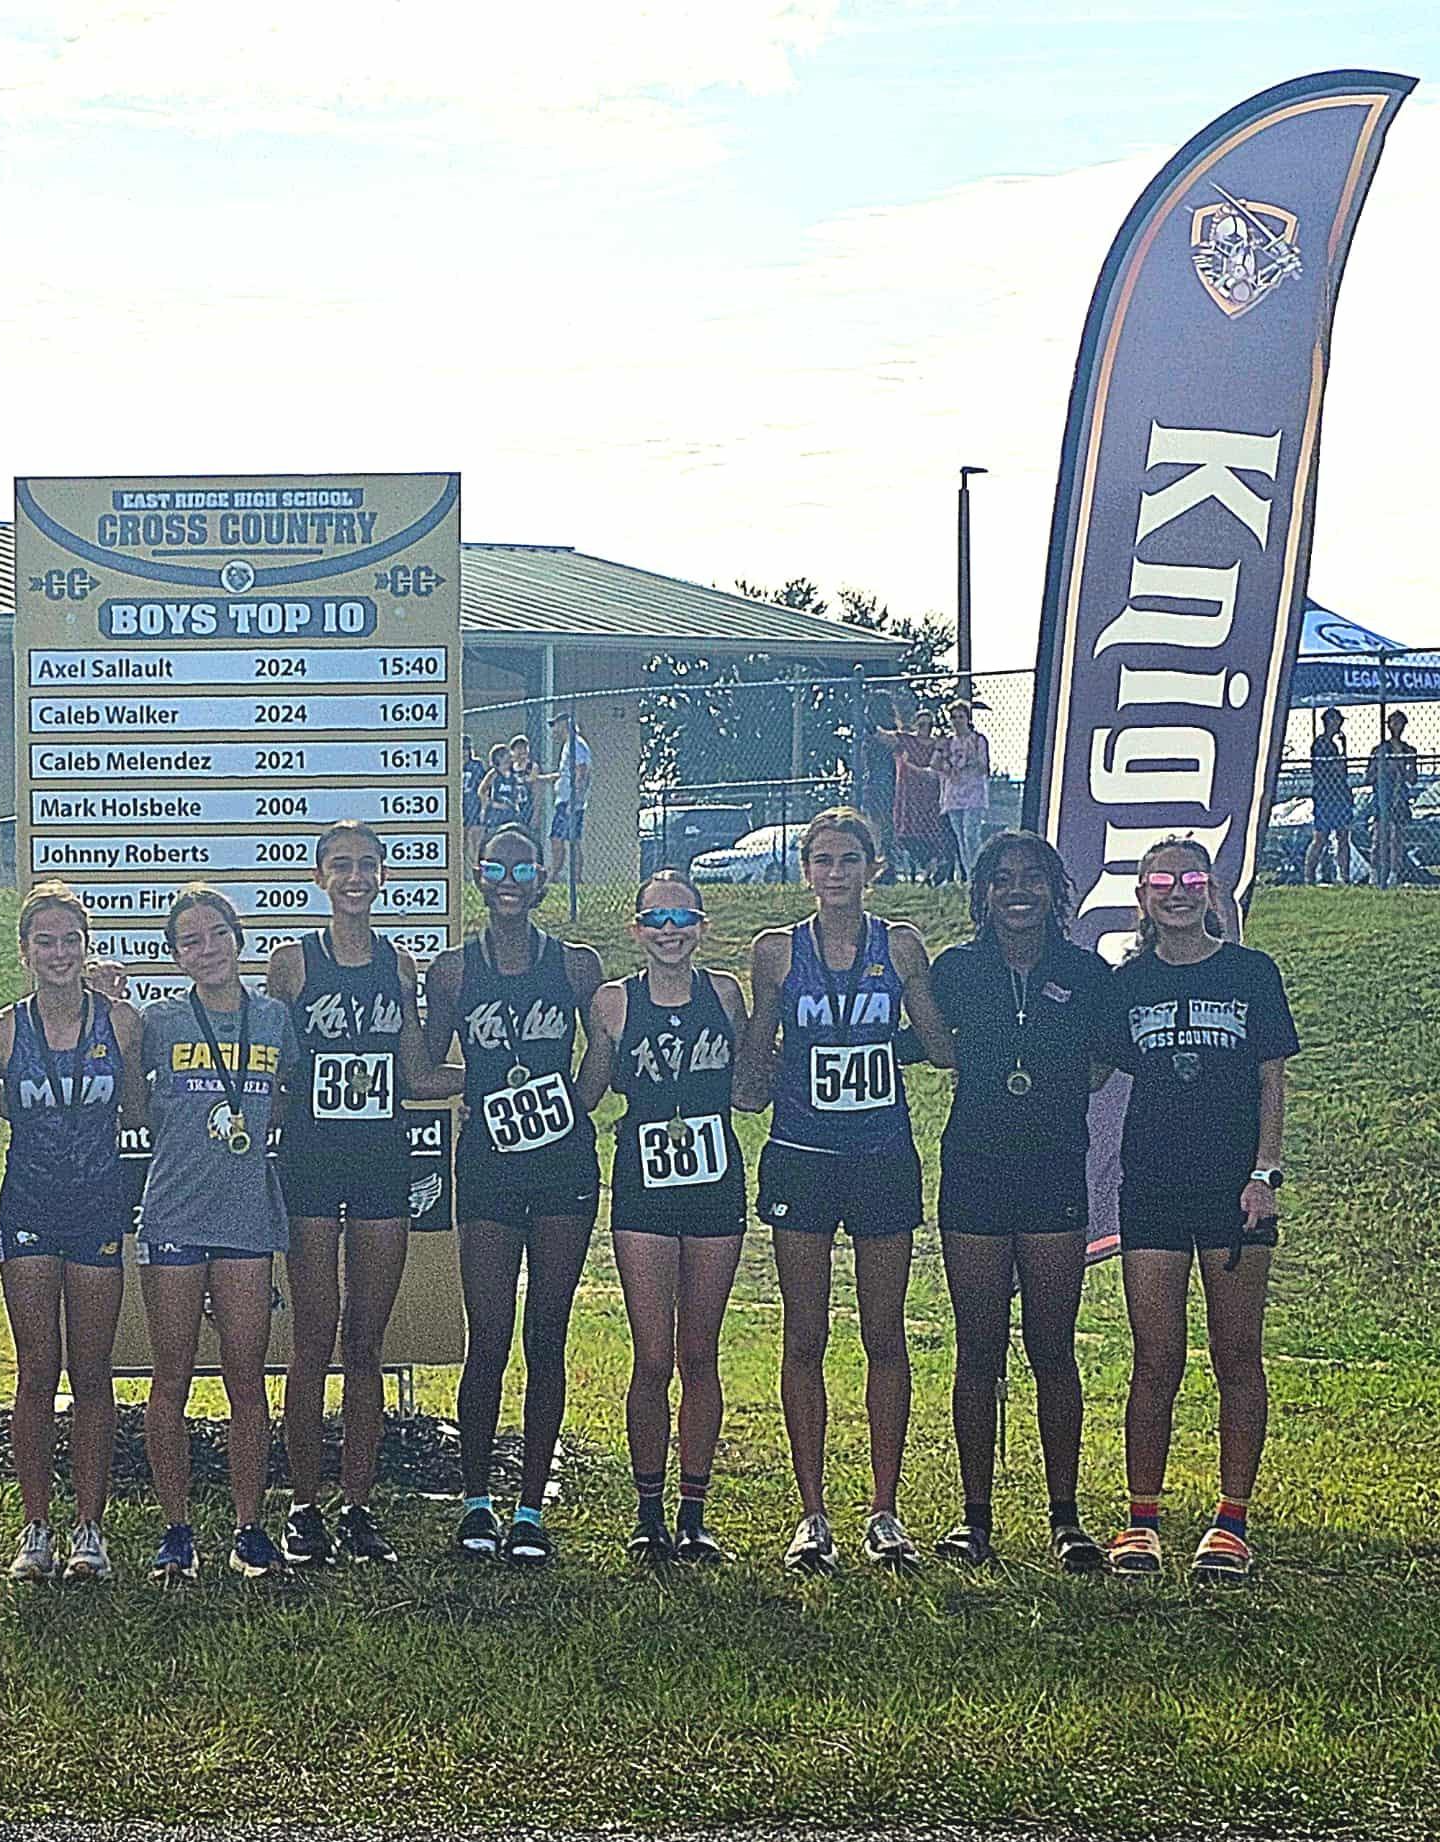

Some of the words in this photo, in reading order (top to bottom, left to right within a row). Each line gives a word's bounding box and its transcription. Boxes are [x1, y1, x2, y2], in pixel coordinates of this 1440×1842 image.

[123, 492, 171, 510] EAST
[175, 492, 228, 509] RIDGE
[234, 491, 278, 508] HIGH
[282, 491, 353, 508] SCHOOL
[98, 512, 208, 546] CROSS
[220, 511, 377, 545] COUNTRY
[110, 603, 217, 635] BOYS
[229, 602, 312, 634] TOP
[323, 601, 364, 633] 10
[39, 659, 85, 678] Axel
[92, 658, 173, 678] Sallault
[255, 658, 307, 677] 2024
[378, 656, 438, 676] 15:40
[39, 706, 100, 725] Caleb
[105, 705, 178, 725] Walker
[255, 704, 307, 724] 2024
[380, 703, 438, 722] 16:04
[40, 752, 101, 772] Caleb
[106, 751, 212, 771] Melendez
[255, 751, 306, 770] 2021
[380, 749, 439, 769] 16:14
[40, 798, 95, 817] Mark
[101, 797, 202, 817] Holsbeke
[255, 797, 308, 816] 2004
[380, 796, 439, 815] 16:30
[40, 844, 117, 868] Johnny
[125, 843, 209, 864] Roberts
[255, 843, 308, 862] 2002
[255, 890, 309, 908] 2009
[380, 888, 439, 907] 16:42
[317, 1058, 389, 1112] 384
[815, 1048, 892, 1104] 540
[488, 1080, 571, 1148] 385
[645, 1121, 721, 1181] 381
